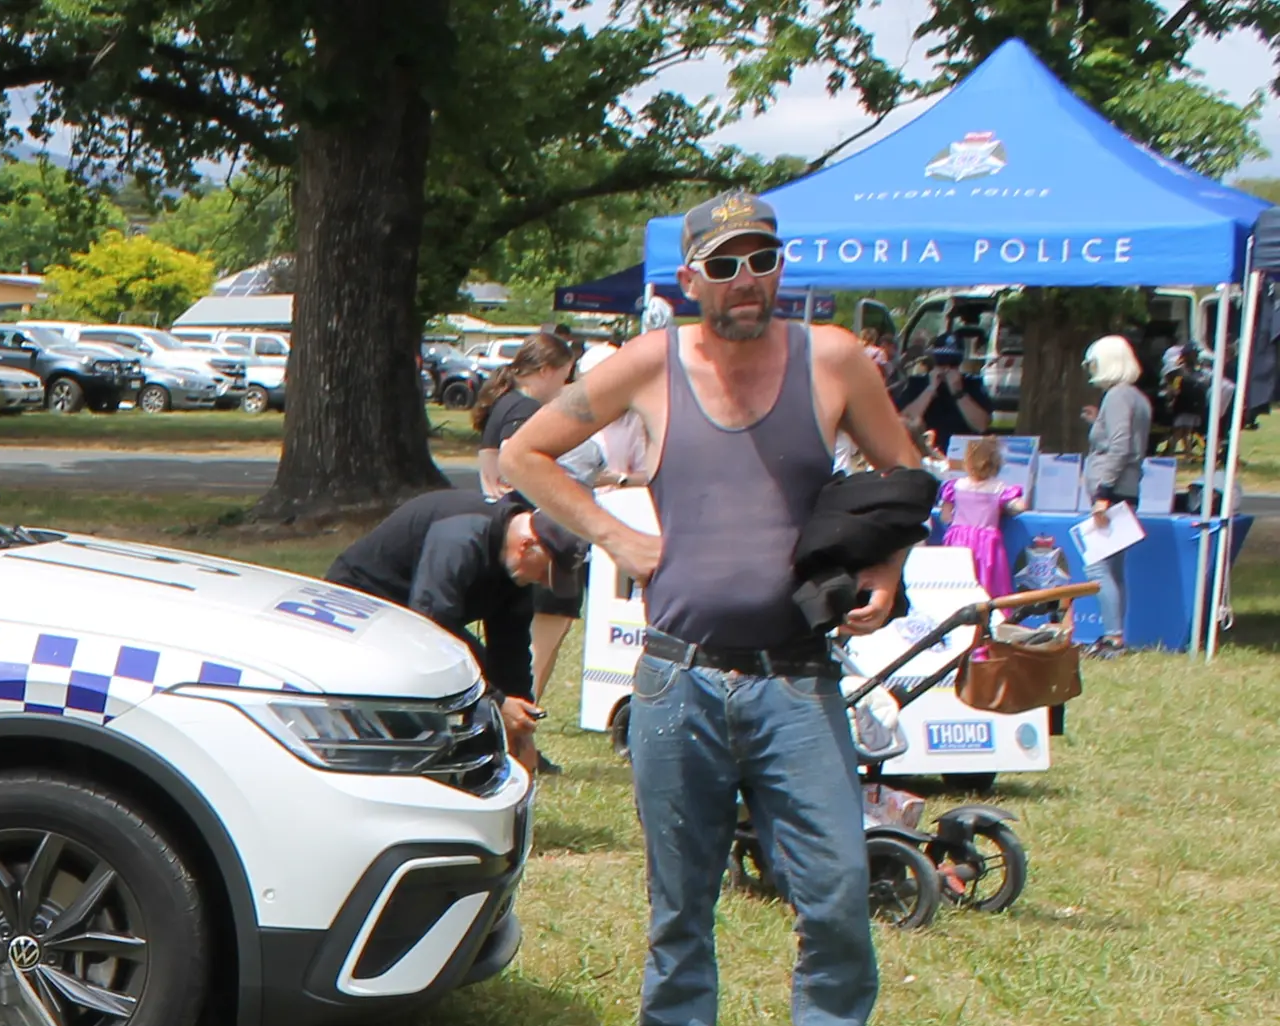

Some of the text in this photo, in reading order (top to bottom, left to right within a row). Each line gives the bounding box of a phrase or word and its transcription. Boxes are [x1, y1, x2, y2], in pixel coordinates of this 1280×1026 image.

[854, 187, 1050, 201] VICTORIA POLICE
[784, 237, 1133, 264] CTORIA POLICE
[609, 625, 647, 646] Poli
